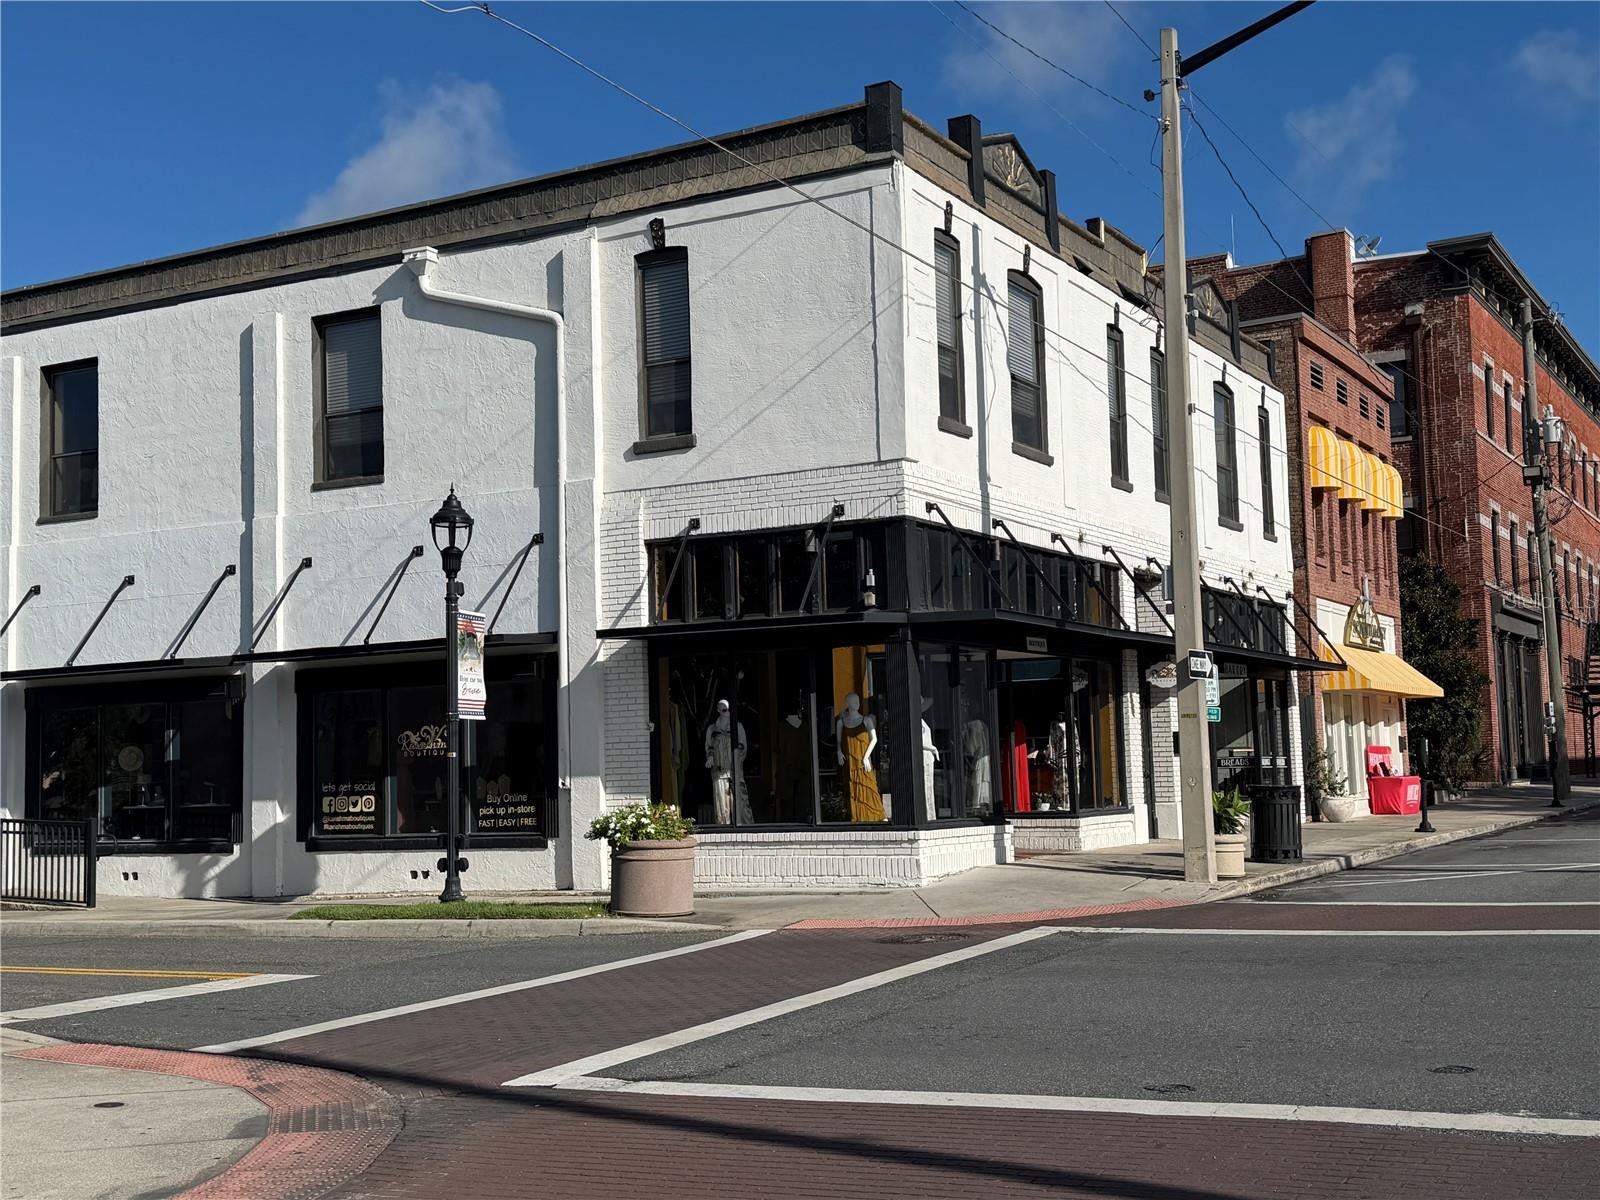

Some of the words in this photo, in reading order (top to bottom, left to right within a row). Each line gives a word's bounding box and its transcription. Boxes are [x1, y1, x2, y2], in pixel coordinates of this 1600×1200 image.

[403, 749, 445, 757] BOUTIQU
[338, 781, 351, 796] get
[353, 781, 376, 792] social
[487, 794, 502, 805] Buy
[503, 793, 528, 803] Online
[479, 805, 495, 817] pick
[496, 806, 506, 816] up
[507, 805, 536, 814] in-store
[478, 819, 495, 828] FAST
[498, 818, 516, 827] EASY
[520, 817, 537, 826] FREE
